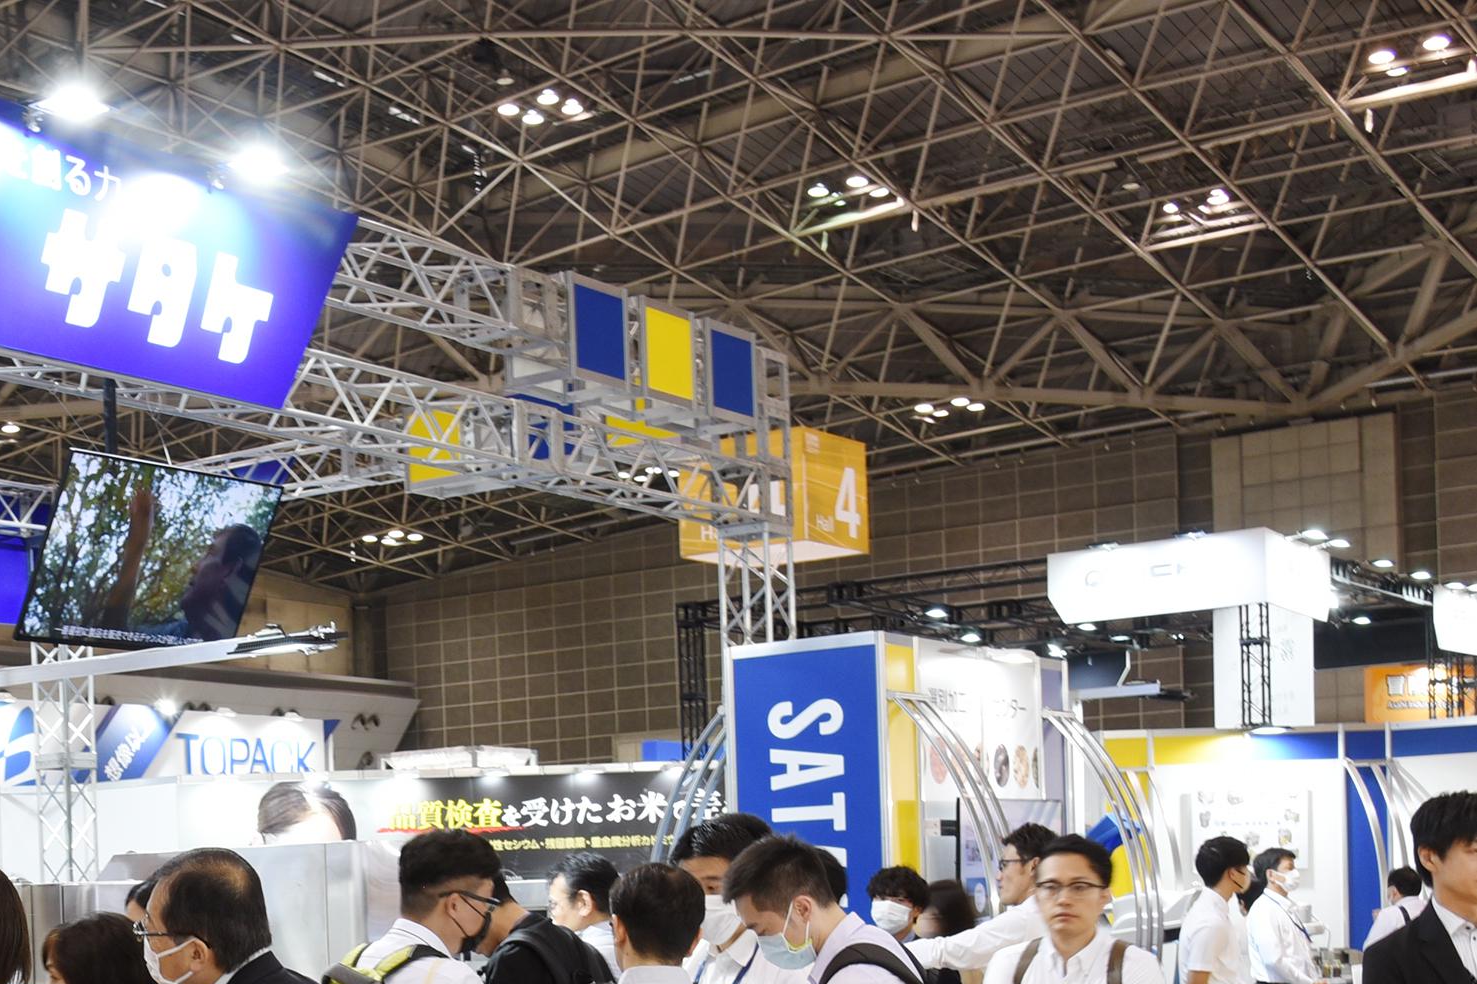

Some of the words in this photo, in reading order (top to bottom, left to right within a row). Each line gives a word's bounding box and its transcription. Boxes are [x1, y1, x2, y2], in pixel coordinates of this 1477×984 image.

[40, 207, 275, 364] サタケ
[816, 514, 836, 534] Hall
[834, 467, 862, 540] 4
[175, 732, 316, 776] TOPACK
